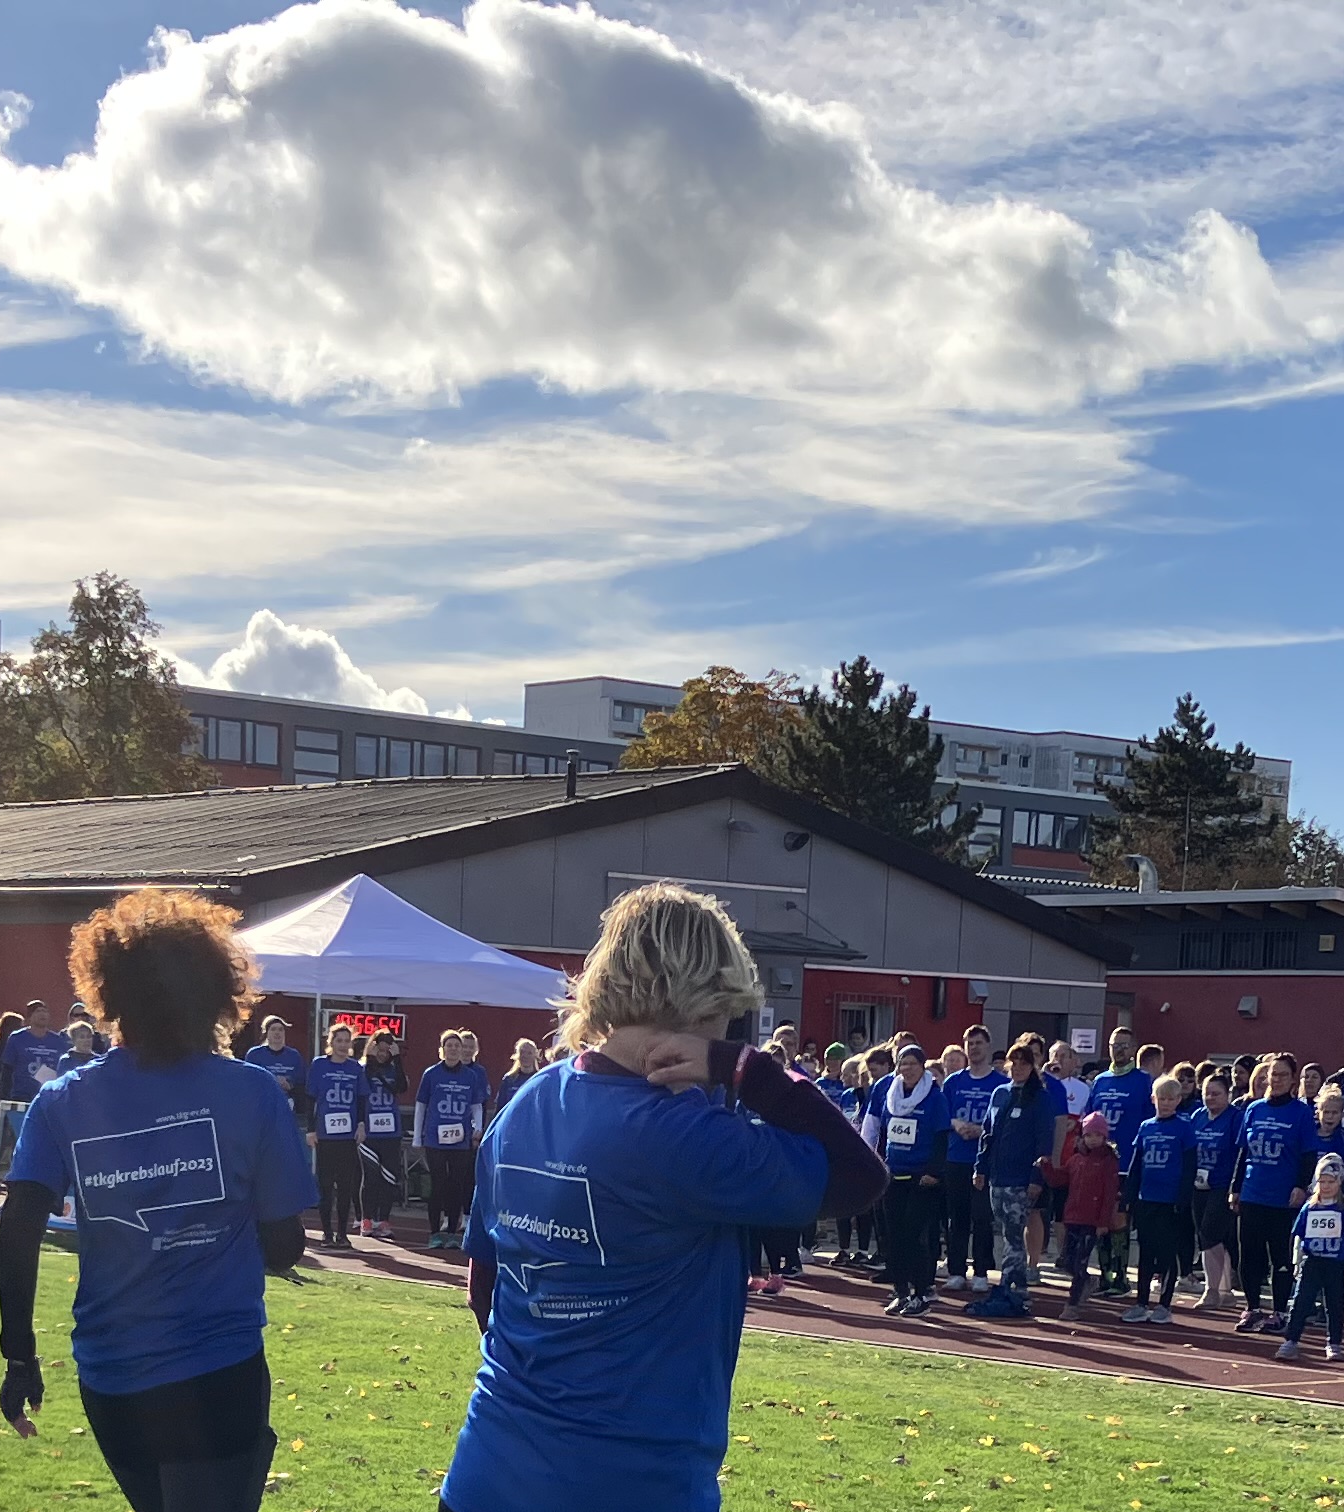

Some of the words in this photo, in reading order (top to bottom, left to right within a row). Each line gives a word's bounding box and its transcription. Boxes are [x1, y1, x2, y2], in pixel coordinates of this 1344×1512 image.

[330, 1117, 348, 1126] 279
[891, 1125, 911, 1135] 464
[84, 1156, 214, 1190] #tkgkrebslauf2023
[1311, 1218, 1336, 1229] 956
